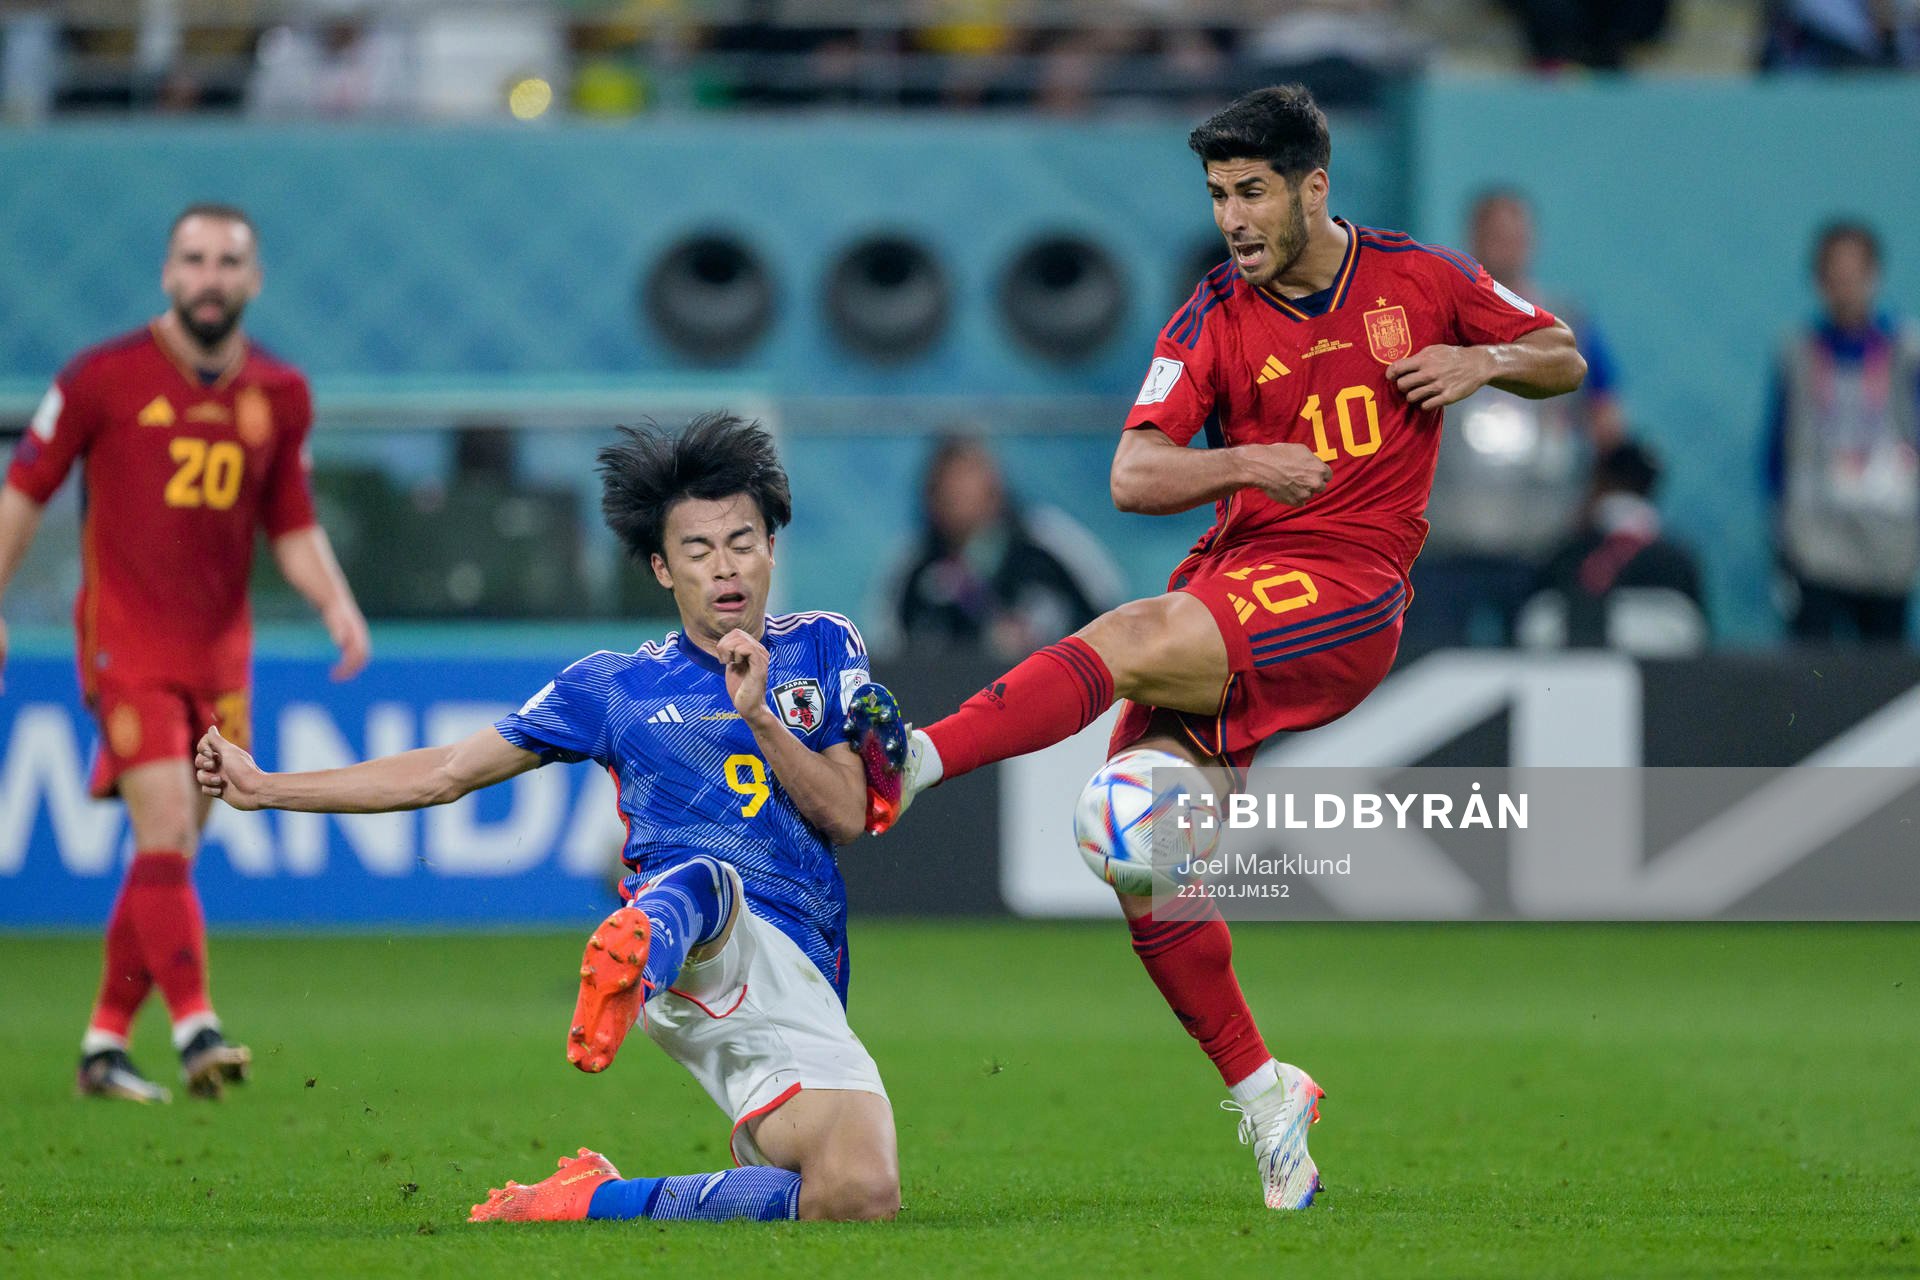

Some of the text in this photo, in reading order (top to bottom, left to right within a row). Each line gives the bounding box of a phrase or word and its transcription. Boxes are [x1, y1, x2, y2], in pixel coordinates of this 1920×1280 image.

[1300, 385, 1382, 462] 10
[165, 437, 244, 509] 20
[784, 680, 808, 690] JAPAN
[723, 754, 770, 818] 9
